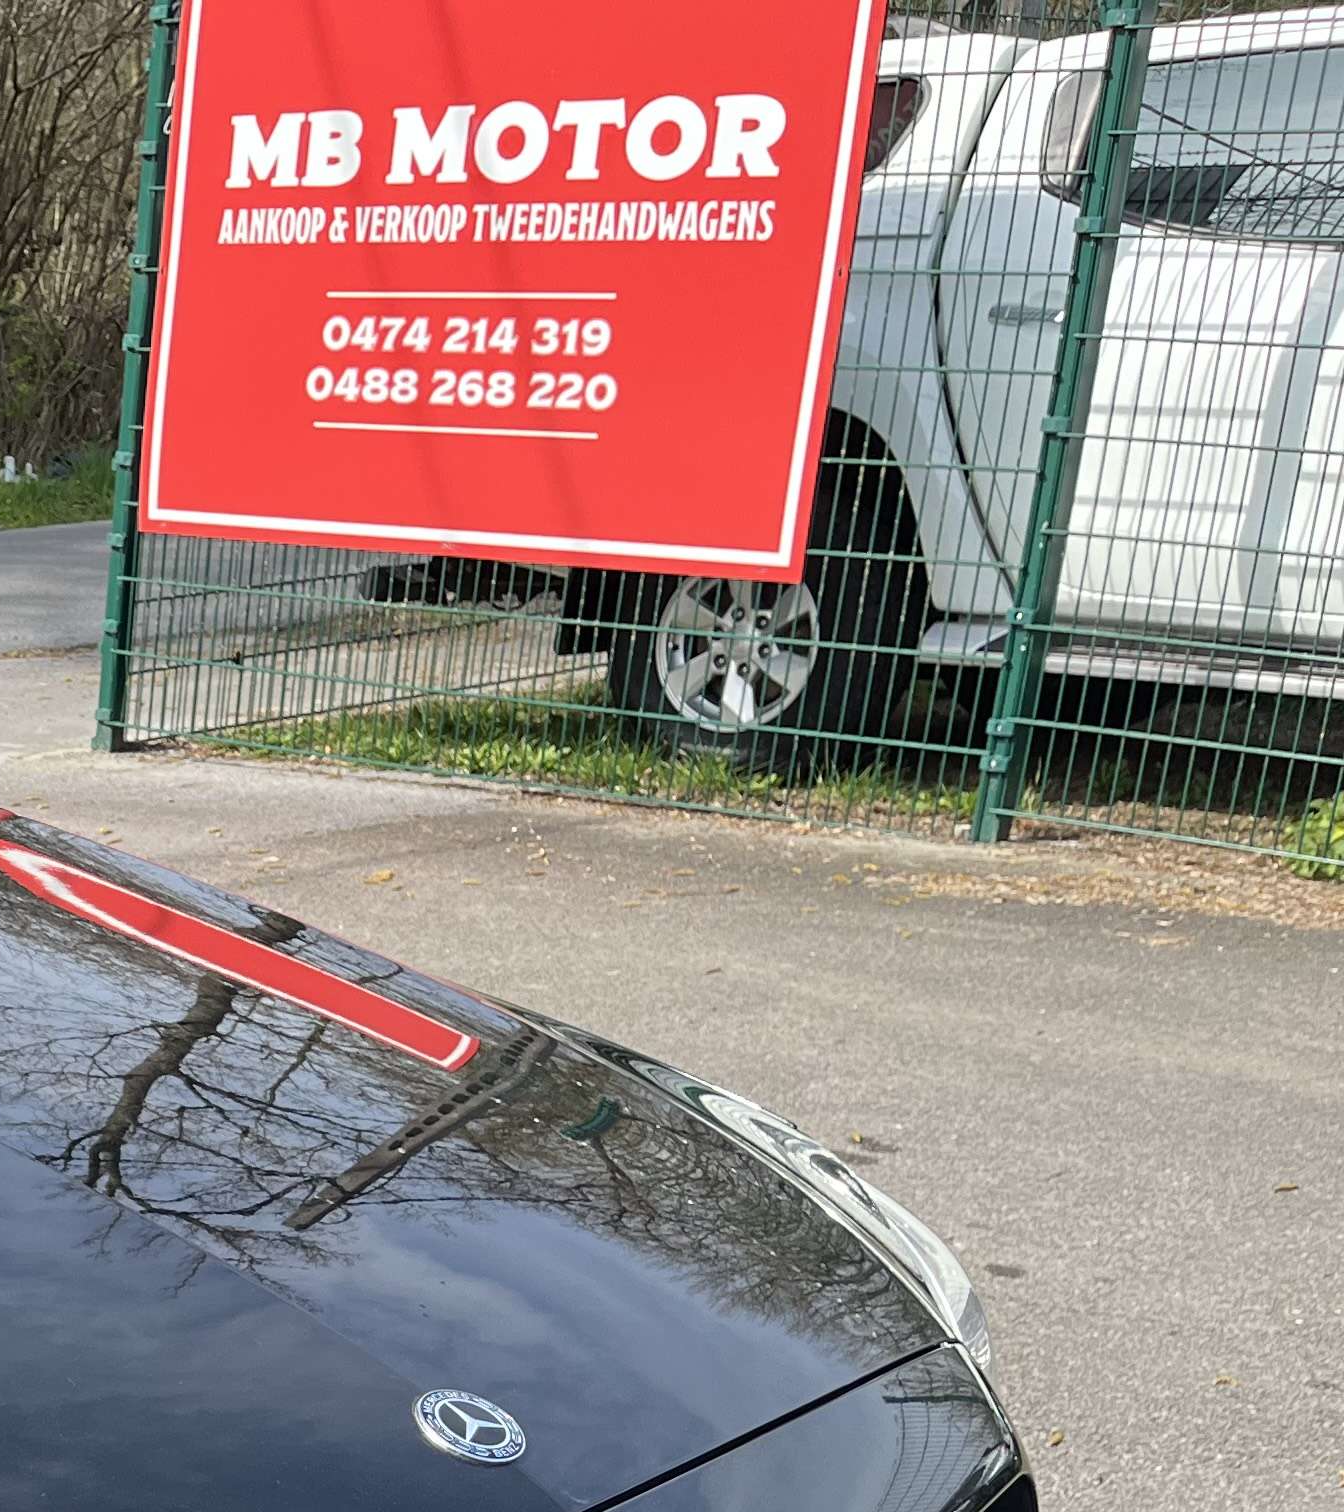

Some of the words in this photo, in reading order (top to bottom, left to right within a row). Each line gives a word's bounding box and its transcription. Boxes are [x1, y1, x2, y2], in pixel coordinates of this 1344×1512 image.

[224, 111, 364, 189] MB
[385, 94, 787, 185] MOTOR
[217, 206, 326, 245] AANKOOP
[328, 206, 349, 244] &
[355, 204, 468, 243] VERKOOP
[472, 201, 776, 242] TWEEDEHANDWAGENS
[322, 315, 432, 352] 0474
[442, 317, 518, 354] 214
[531, 318, 611, 356] 319
[306, 366, 419, 404] 0488
[429, 369, 516, 407] 268
[527, 372, 618, 410] 220
[492, 1442, 520, 1458] BENZ
